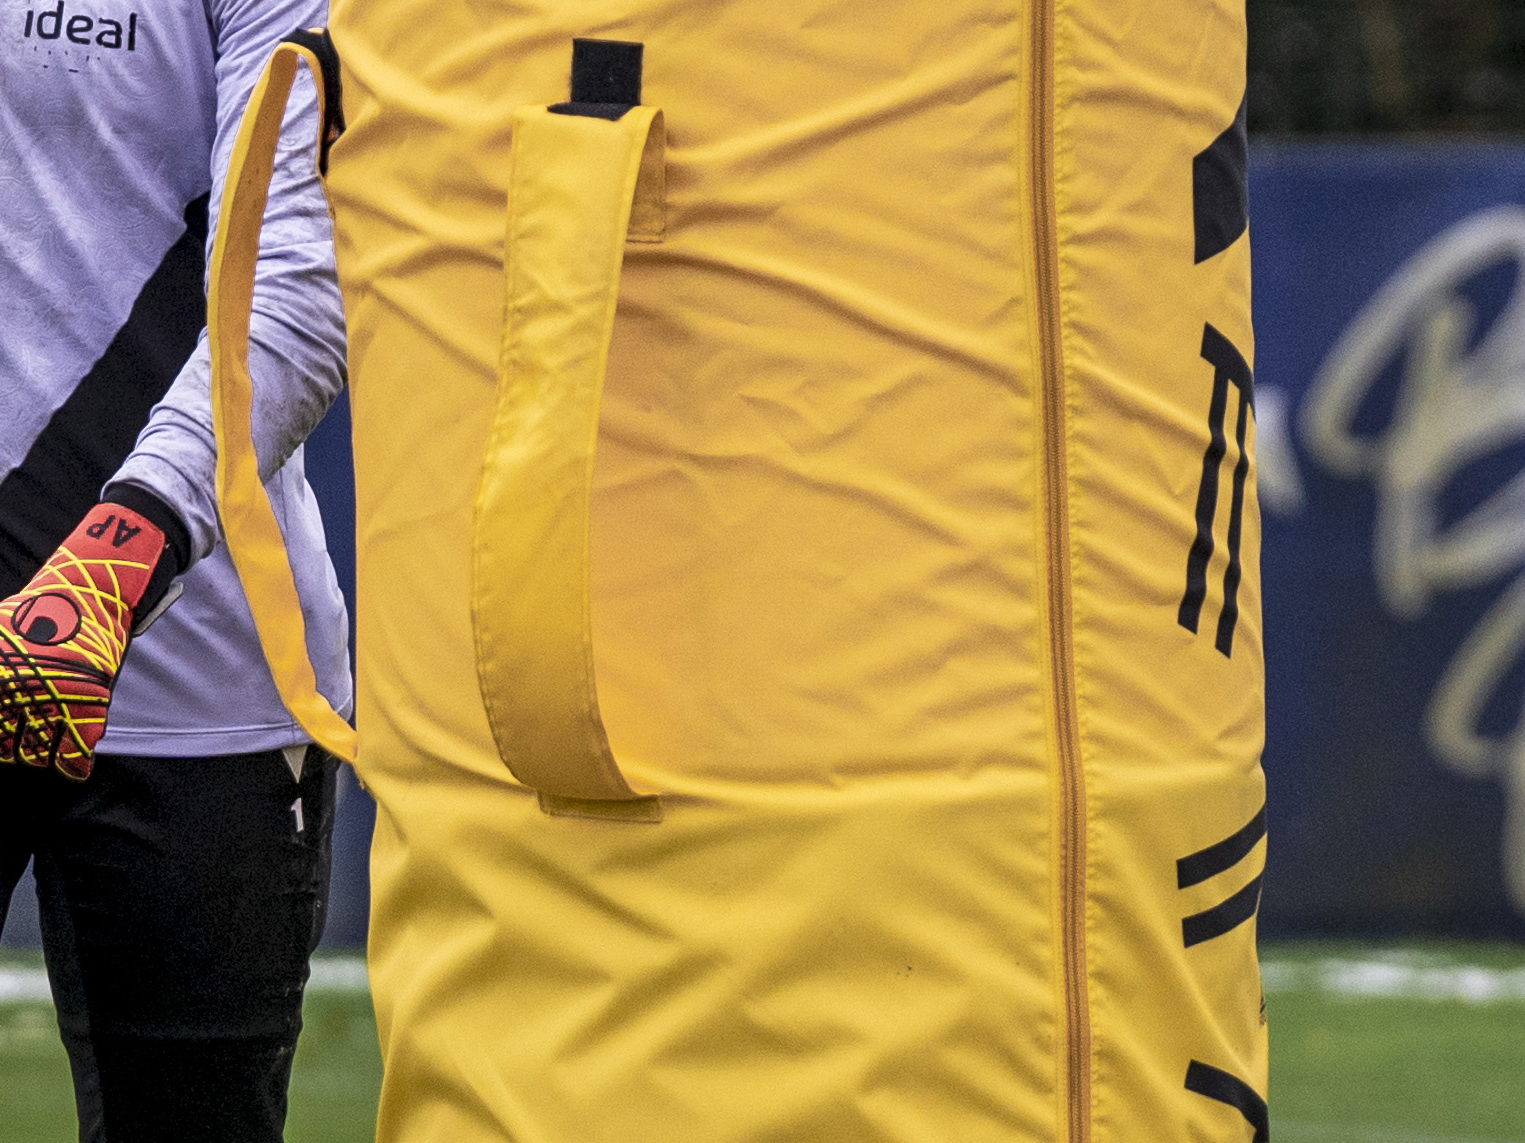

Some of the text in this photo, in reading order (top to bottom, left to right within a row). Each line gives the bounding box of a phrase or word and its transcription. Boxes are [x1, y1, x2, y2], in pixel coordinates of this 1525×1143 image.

[24, 0, 137, 51] ideal
[86, 514, 142, 548] AP
[290, 797, 304, 832] 1
